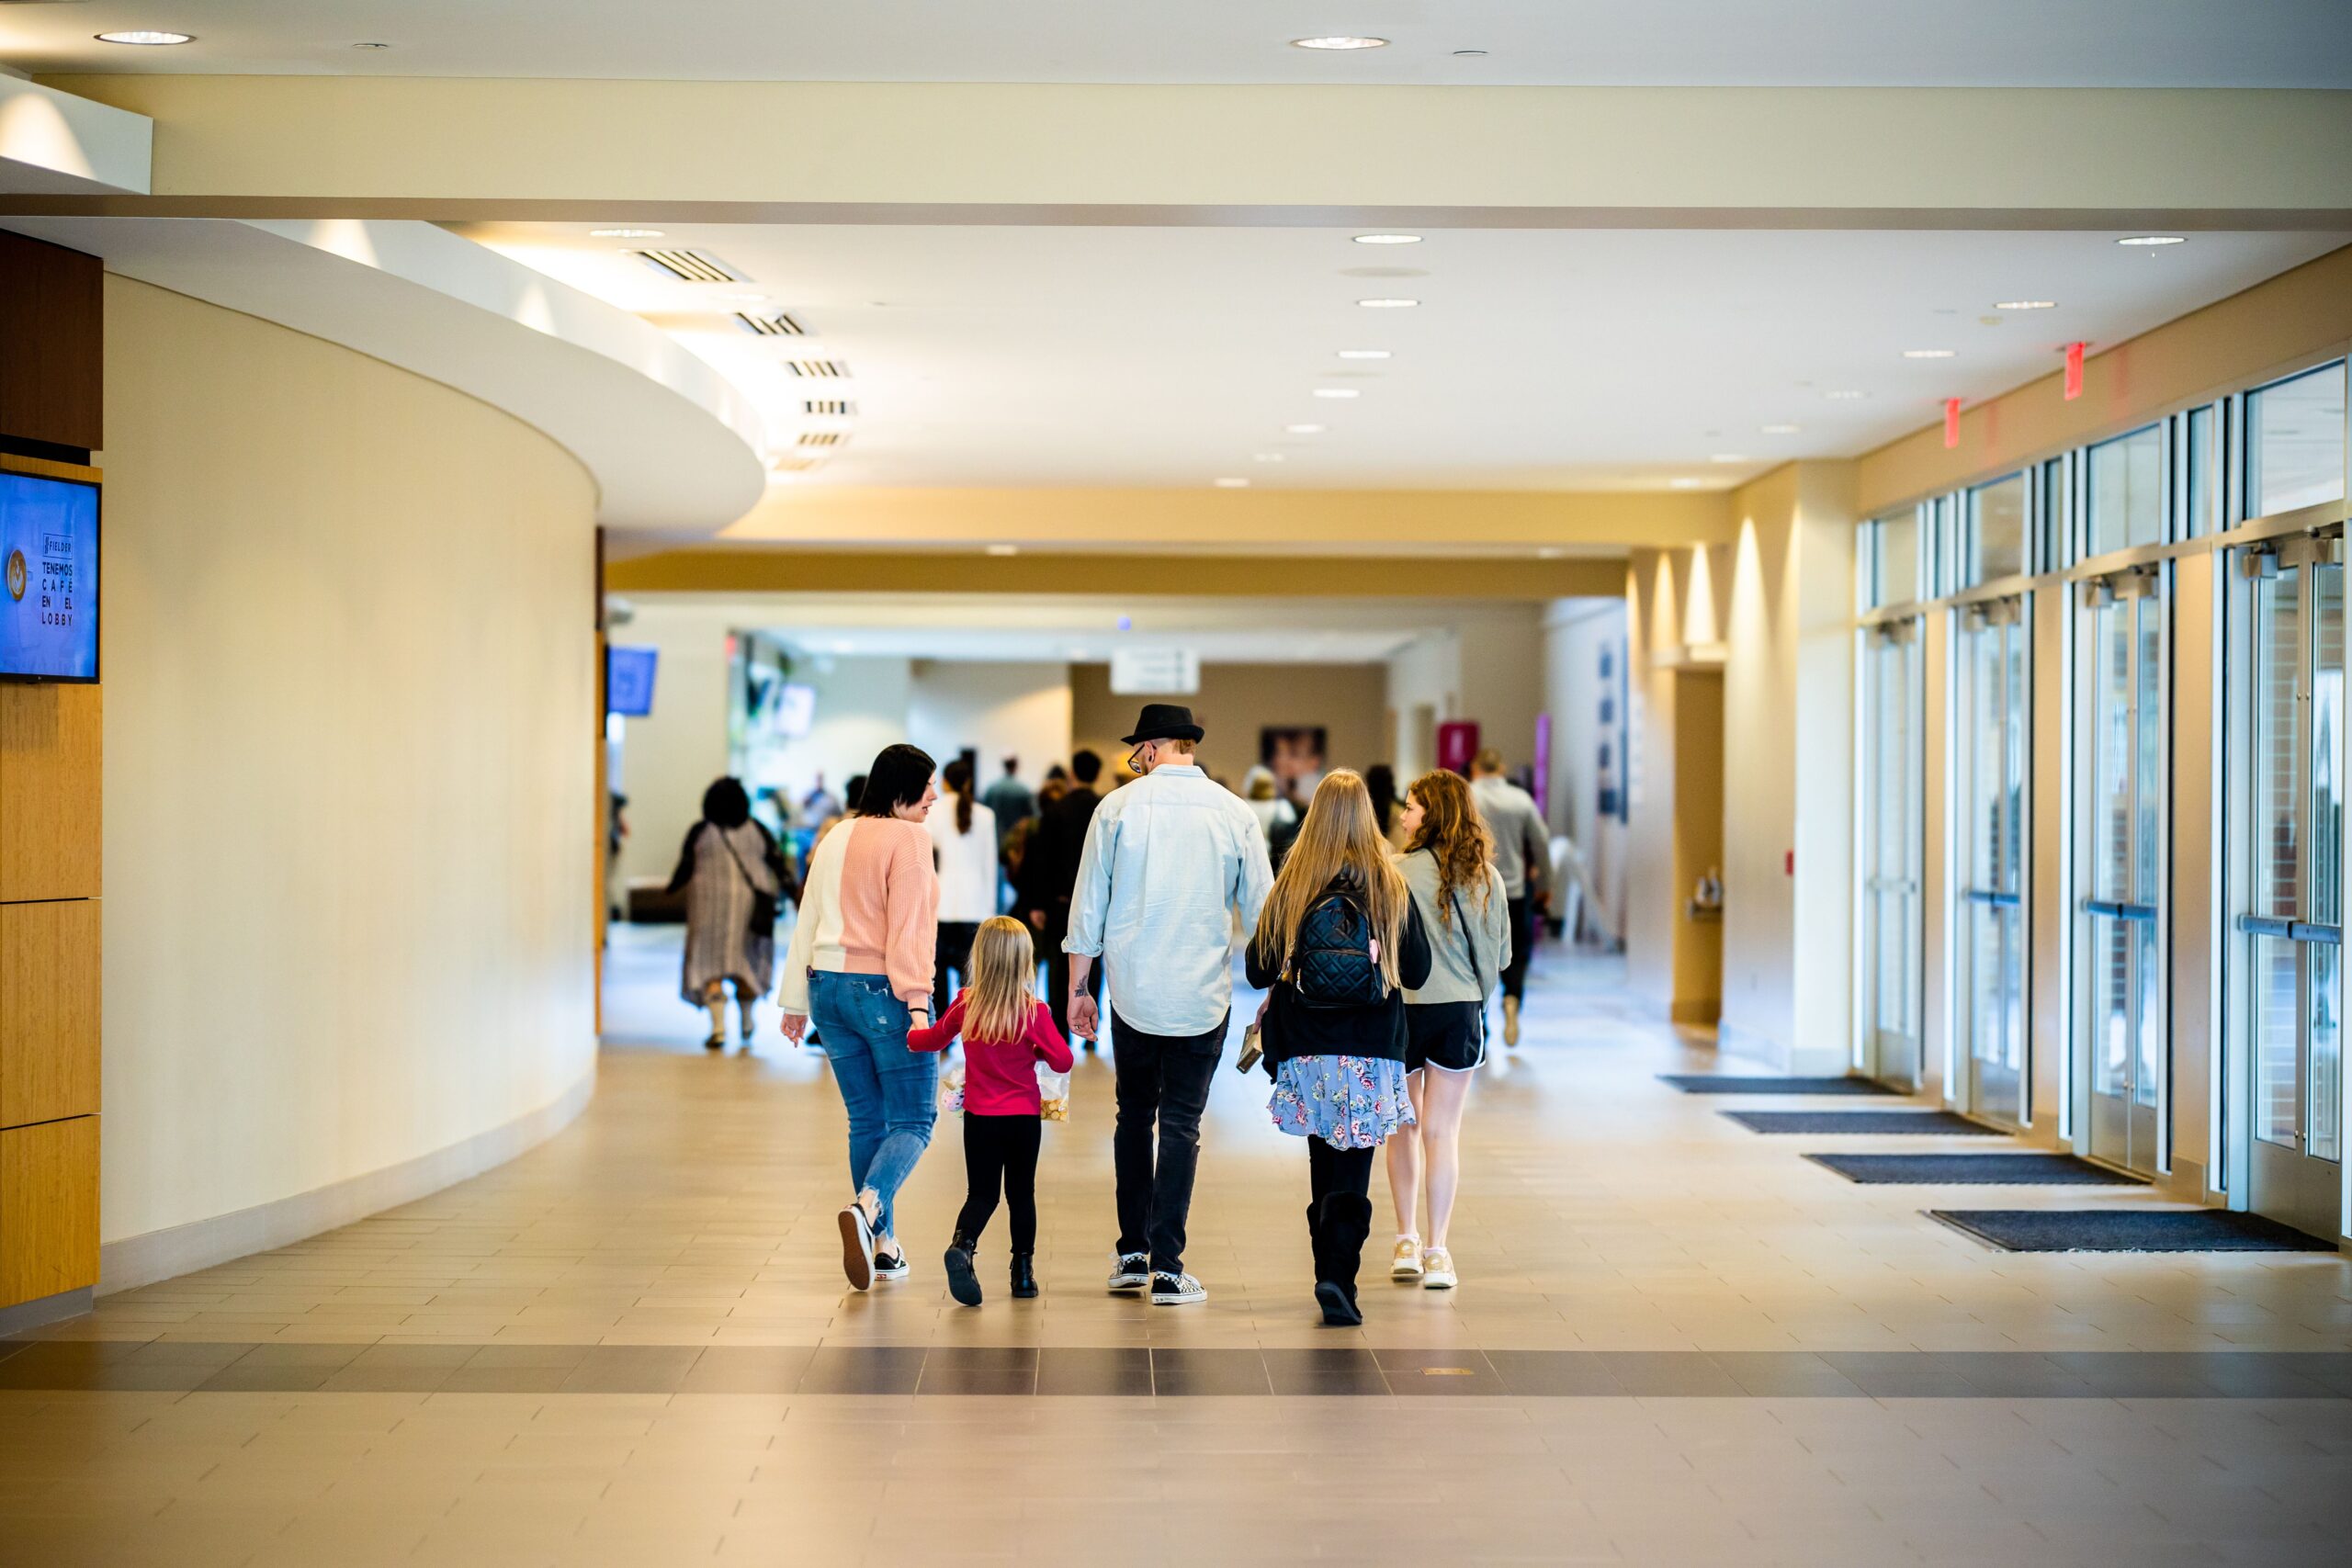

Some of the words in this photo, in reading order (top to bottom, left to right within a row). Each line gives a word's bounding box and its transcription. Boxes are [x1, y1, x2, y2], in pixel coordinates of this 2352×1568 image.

[49, 540, 72, 553] FIELDER
[42, 561, 73, 577] TENEMOS
[42, 578, 73, 593] CAFÉ
[41, 595, 51, 608] EN
[64, 597, 73, 610] EL
[41, 612, 73, 626] LOBBY
